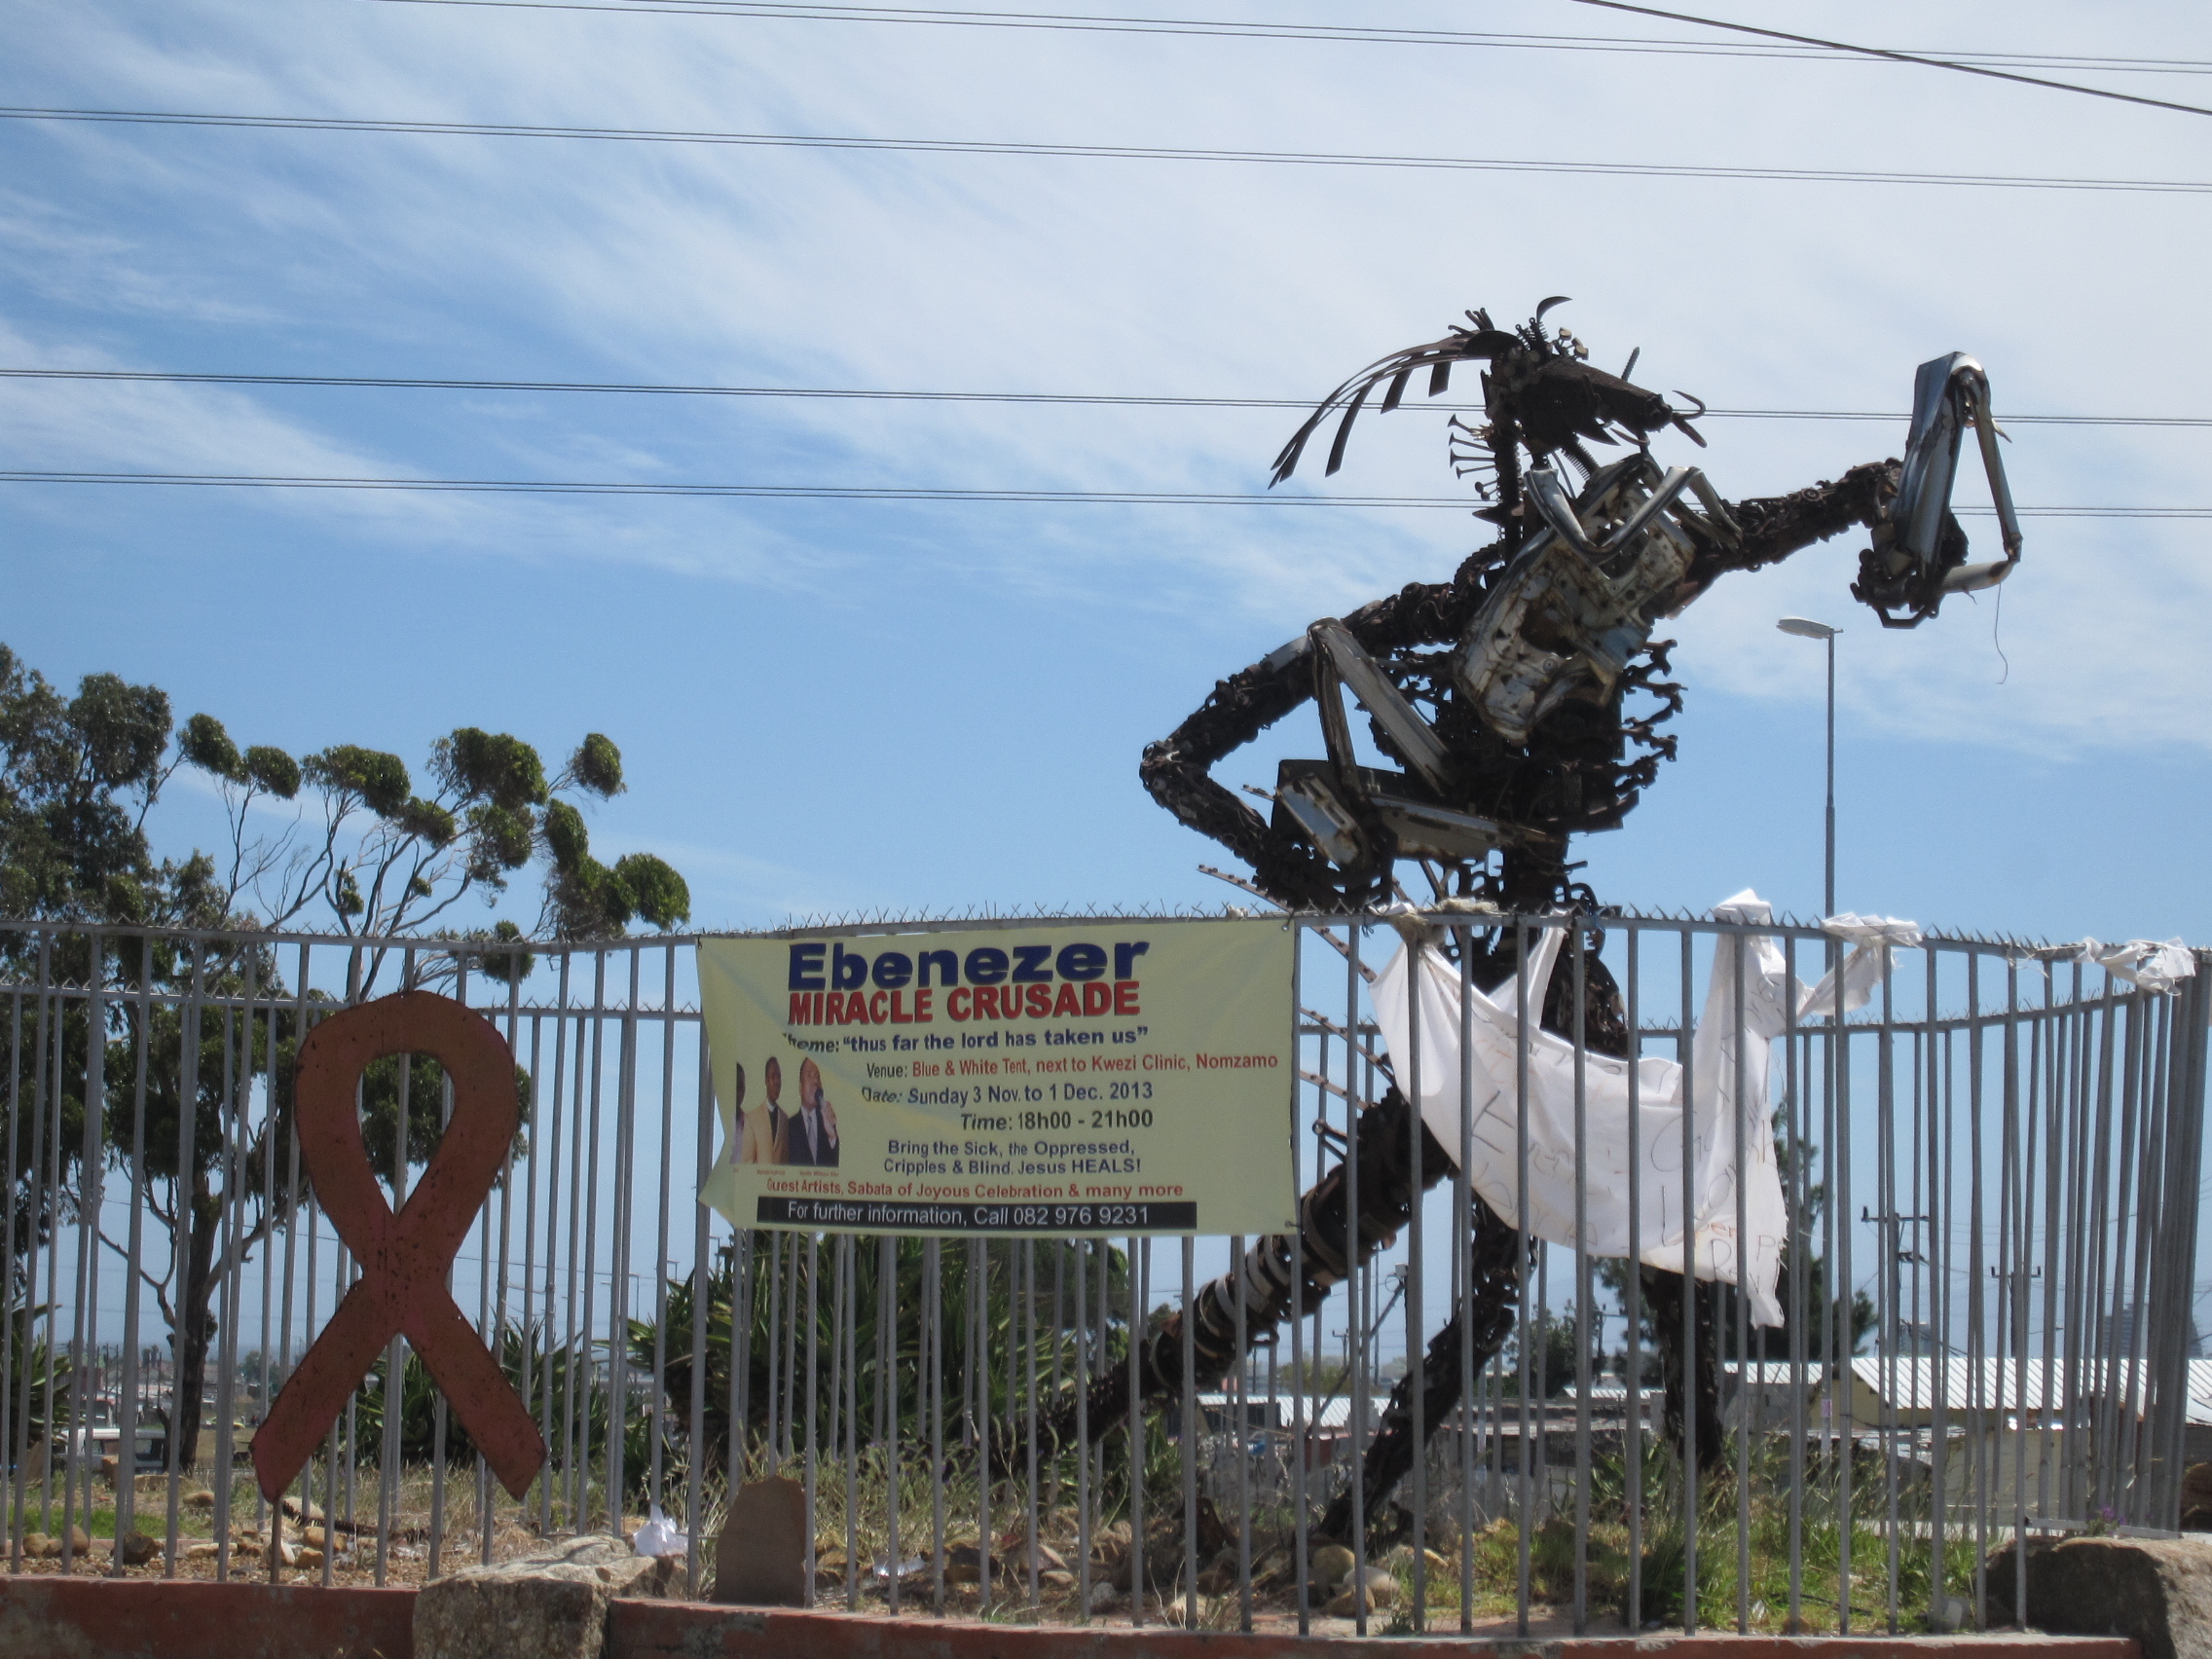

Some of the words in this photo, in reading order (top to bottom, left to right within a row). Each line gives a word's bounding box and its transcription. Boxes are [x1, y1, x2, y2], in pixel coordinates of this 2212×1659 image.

[789, 940, 1150, 991] Ebenezer
[788, 989, 934, 1025] MIRACLE
[946, 980, 1140, 1022] CRUSADE
[783, 1032, 840, 1052] heme:
[893, 1034, 919, 1051] far
[924, 1034, 955, 1050] the
[961, 1031, 999, 1049] lord
[1005, 1030, 1037, 1047] has
[1045, 1028, 1104, 1046] taken
[866, 1062, 907, 1079] Venue:
[912, 1061, 940, 1077] Blue
[944, 1060, 955, 1076] &
[959, 1058, 998, 1075] White
[1002, 1057, 1030, 1075] Tent,
[1036, 1057, 1068, 1073] next
[1072, 1057, 1087, 1072] to
[1091, 1055, 1136, 1071] Kwezi
[1142, 1054, 1191, 1072] Clinic,
[1196, 1052, 1278, 1069] Nomzamo
[907, 1088, 968, 1108] Sunday
[973, 1087, 981, 1103] 3
[1024, 1085, 1043, 1101] to
[1050, 1084, 1057, 1101] 1
[1064, 1083, 1102, 1100] Dec.
[1109, 1081, 1153, 1099] 2013
[961, 1113, 1013, 1130] Time:
[1018, 1111, 1071, 1129] 18h00
[1091, 1109, 1154, 1128] 21h00
[888, 1139, 929, 1158] Bring
[933, 1141, 959, 1156] the
[964, 1142, 1003, 1158] Sick,
[1009, 1142, 1028, 1156] the
[1034, 1139, 1135, 1159] Oppressed,
[884, 1159, 946, 1176] Cripples
[952, 1161, 964, 1174] &
[1018, 1161, 1066, 1175] Jesus
[1072, 1158, 1141, 1173] HEALS!
[766, 1178, 799, 1193] Guest
[801, 1180, 844, 1196] Artists,
[847, 1181, 893, 1196] Sabata
[898, 1182, 913, 1197] of
[916, 1183, 971, 1200] Joyous
[975, 1184, 1063, 1198] Celebration
[1068, 1183, 1080, 1198] &
[1086, 1185, 1132, 1200] many
[1138, 1184, 1184, 1197] more
[788, 1200, 809, 1218] For
[813, 1201, 864, 1222] further
[867, 1204, 968, 1227] information,
[974, 1206, 1009, 1225] Call
[1014, 1206, 1049, 1225] 082
[1055, 1206, 1092, 1225] 976
[1099, 1205, 1148, 1225] 9231
